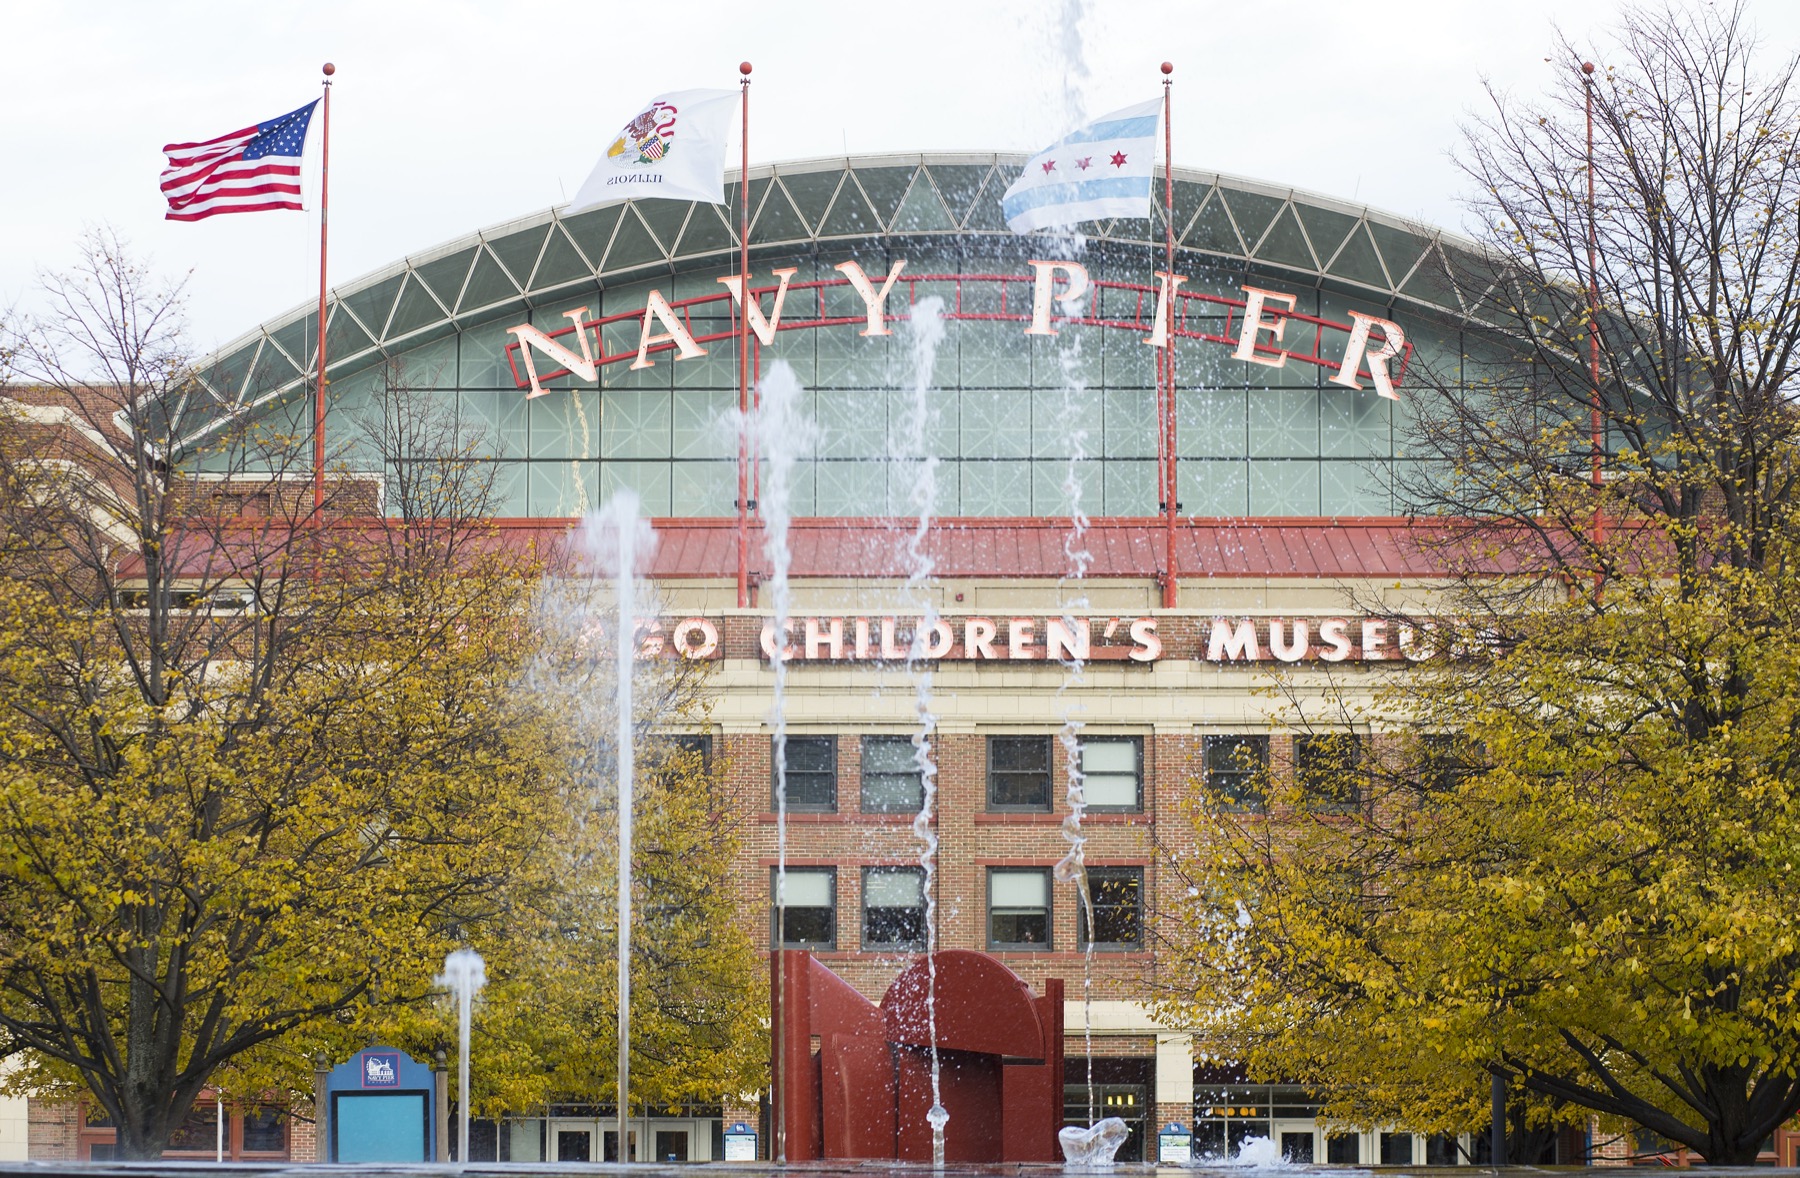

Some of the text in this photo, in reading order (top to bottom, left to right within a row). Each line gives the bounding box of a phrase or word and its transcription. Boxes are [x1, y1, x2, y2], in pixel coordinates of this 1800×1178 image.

[507, 259, 1405, 401] NAVY PIER
[760, 616, 1163, 662] CHILDREN'S
